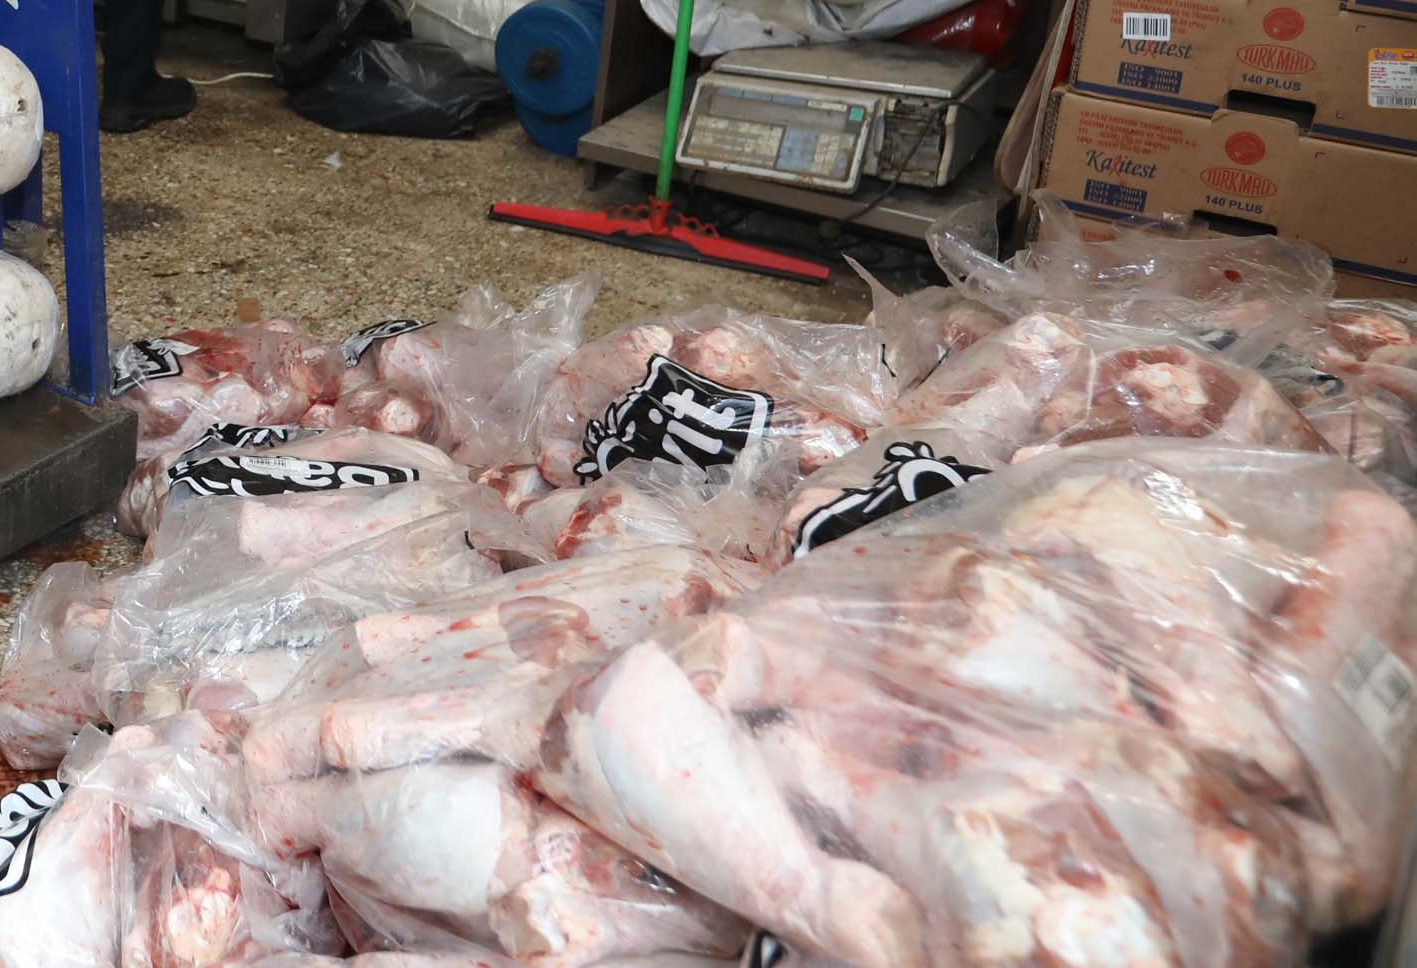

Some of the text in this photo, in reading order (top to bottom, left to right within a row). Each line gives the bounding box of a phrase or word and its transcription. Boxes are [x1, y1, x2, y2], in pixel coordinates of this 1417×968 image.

[1243, 73, 1302, 92] 140 PLUS
[1206, 195, 1264, 214] 140 PLUS
